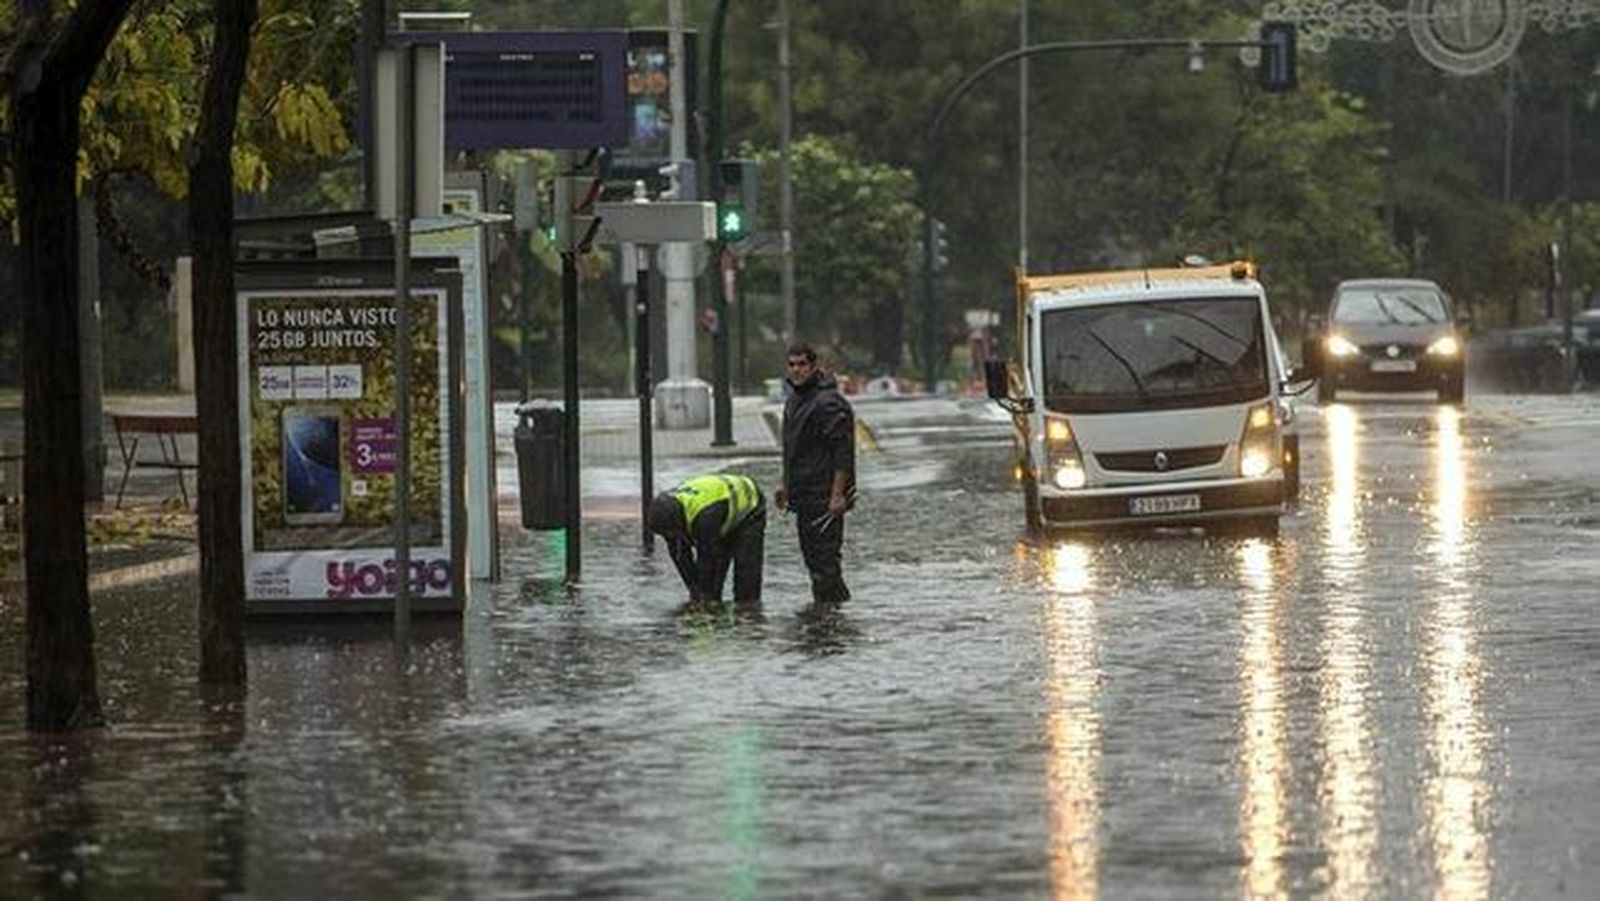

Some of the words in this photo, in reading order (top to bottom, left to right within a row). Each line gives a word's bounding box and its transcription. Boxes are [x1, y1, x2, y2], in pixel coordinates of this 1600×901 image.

[258, 310, 278, 327] LO
[284, 308, 344, 327] NUNCA
[258, 331, 305, 349] 25GB
